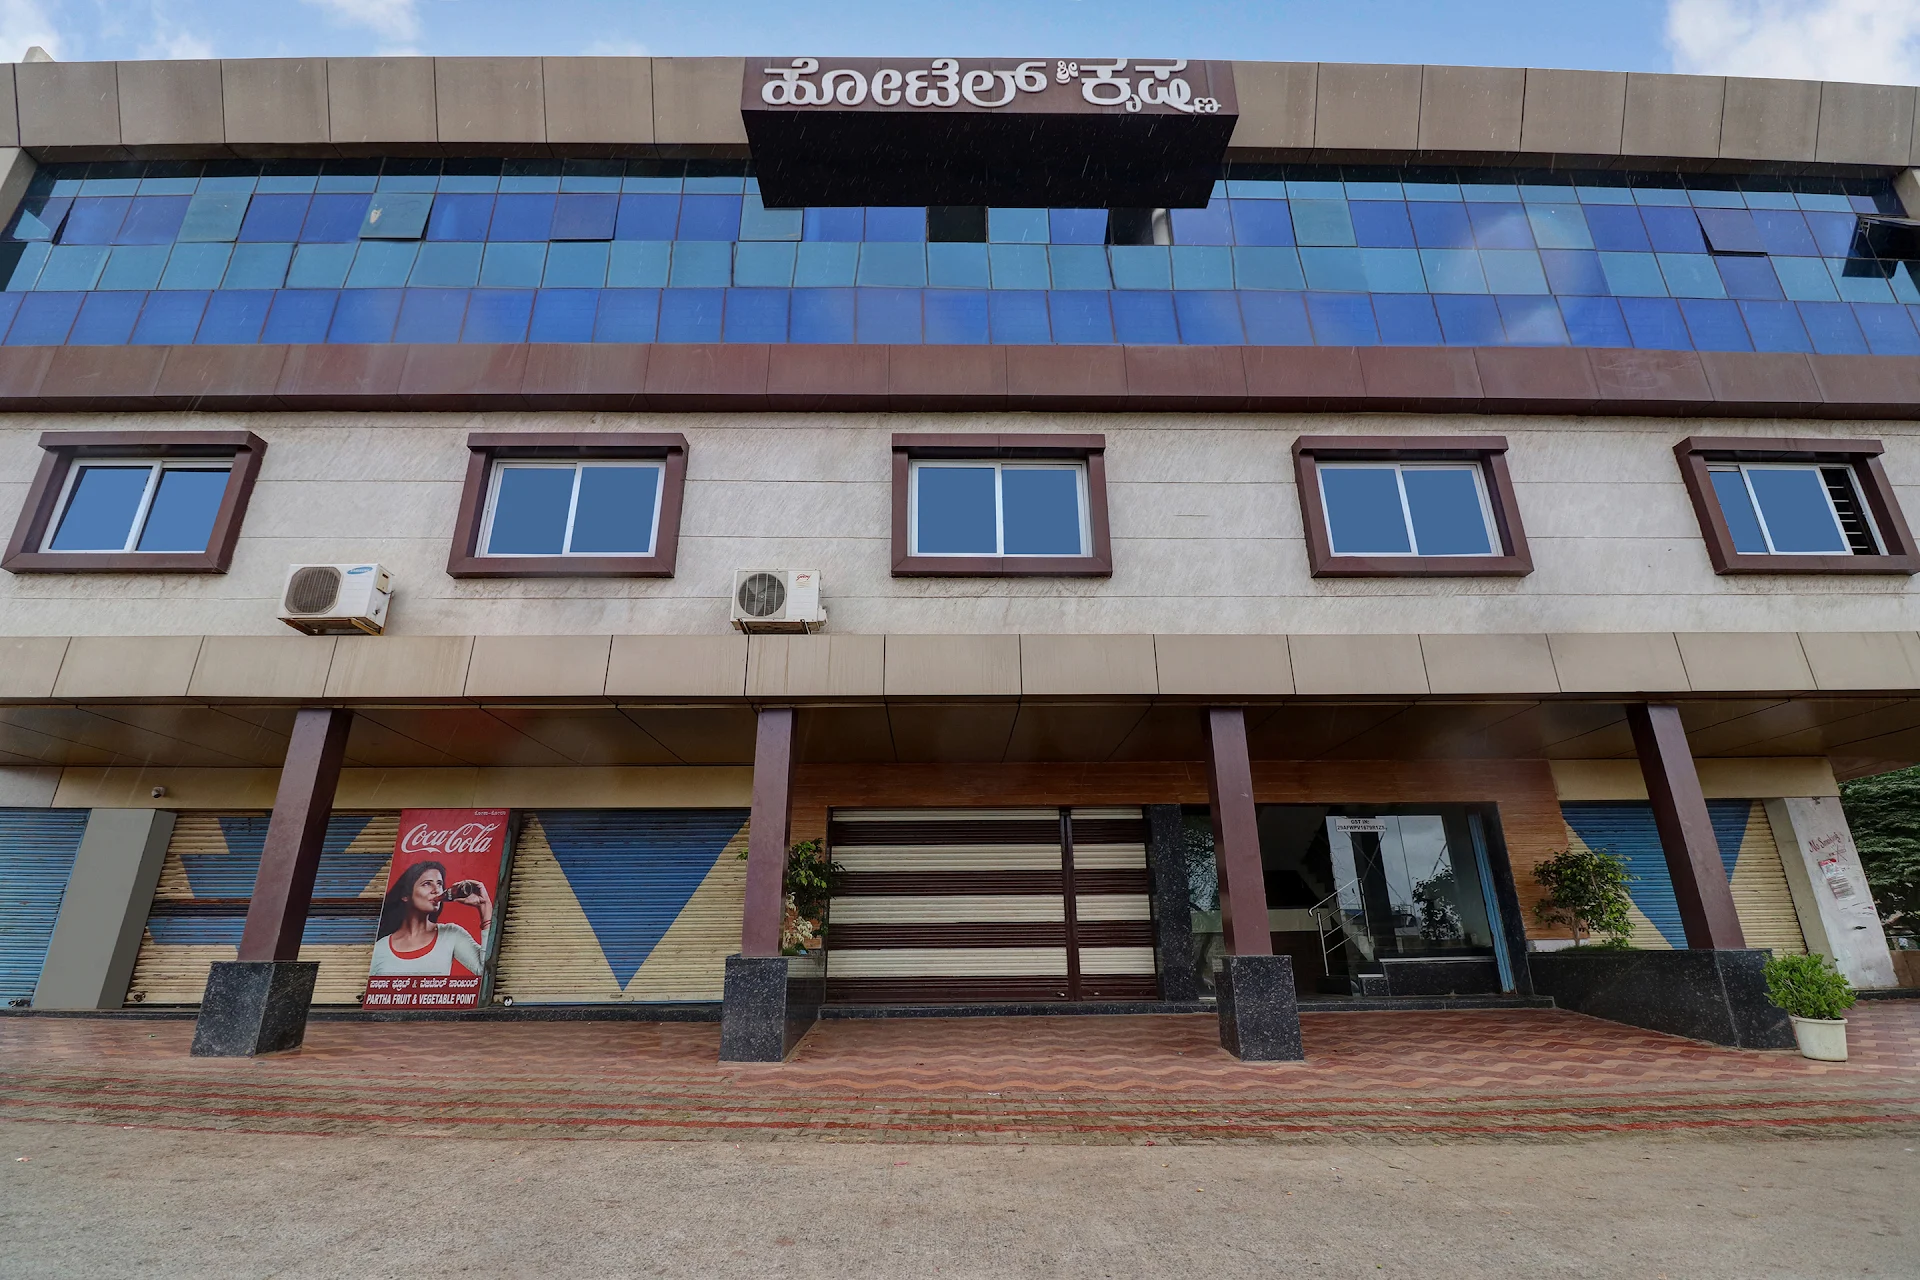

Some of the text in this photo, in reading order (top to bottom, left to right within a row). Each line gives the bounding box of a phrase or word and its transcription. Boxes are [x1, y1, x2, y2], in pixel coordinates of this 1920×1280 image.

[761, 58, 1222, 113] ಹೋಟೆಲ್ ಶ್ರೀ ಕೃಷ್ಣ
[401, 823, 500, 853] Coca-Cola
[366, 994, 476, 1004] PARTHA FRUIT & VEGETABLE POINT
